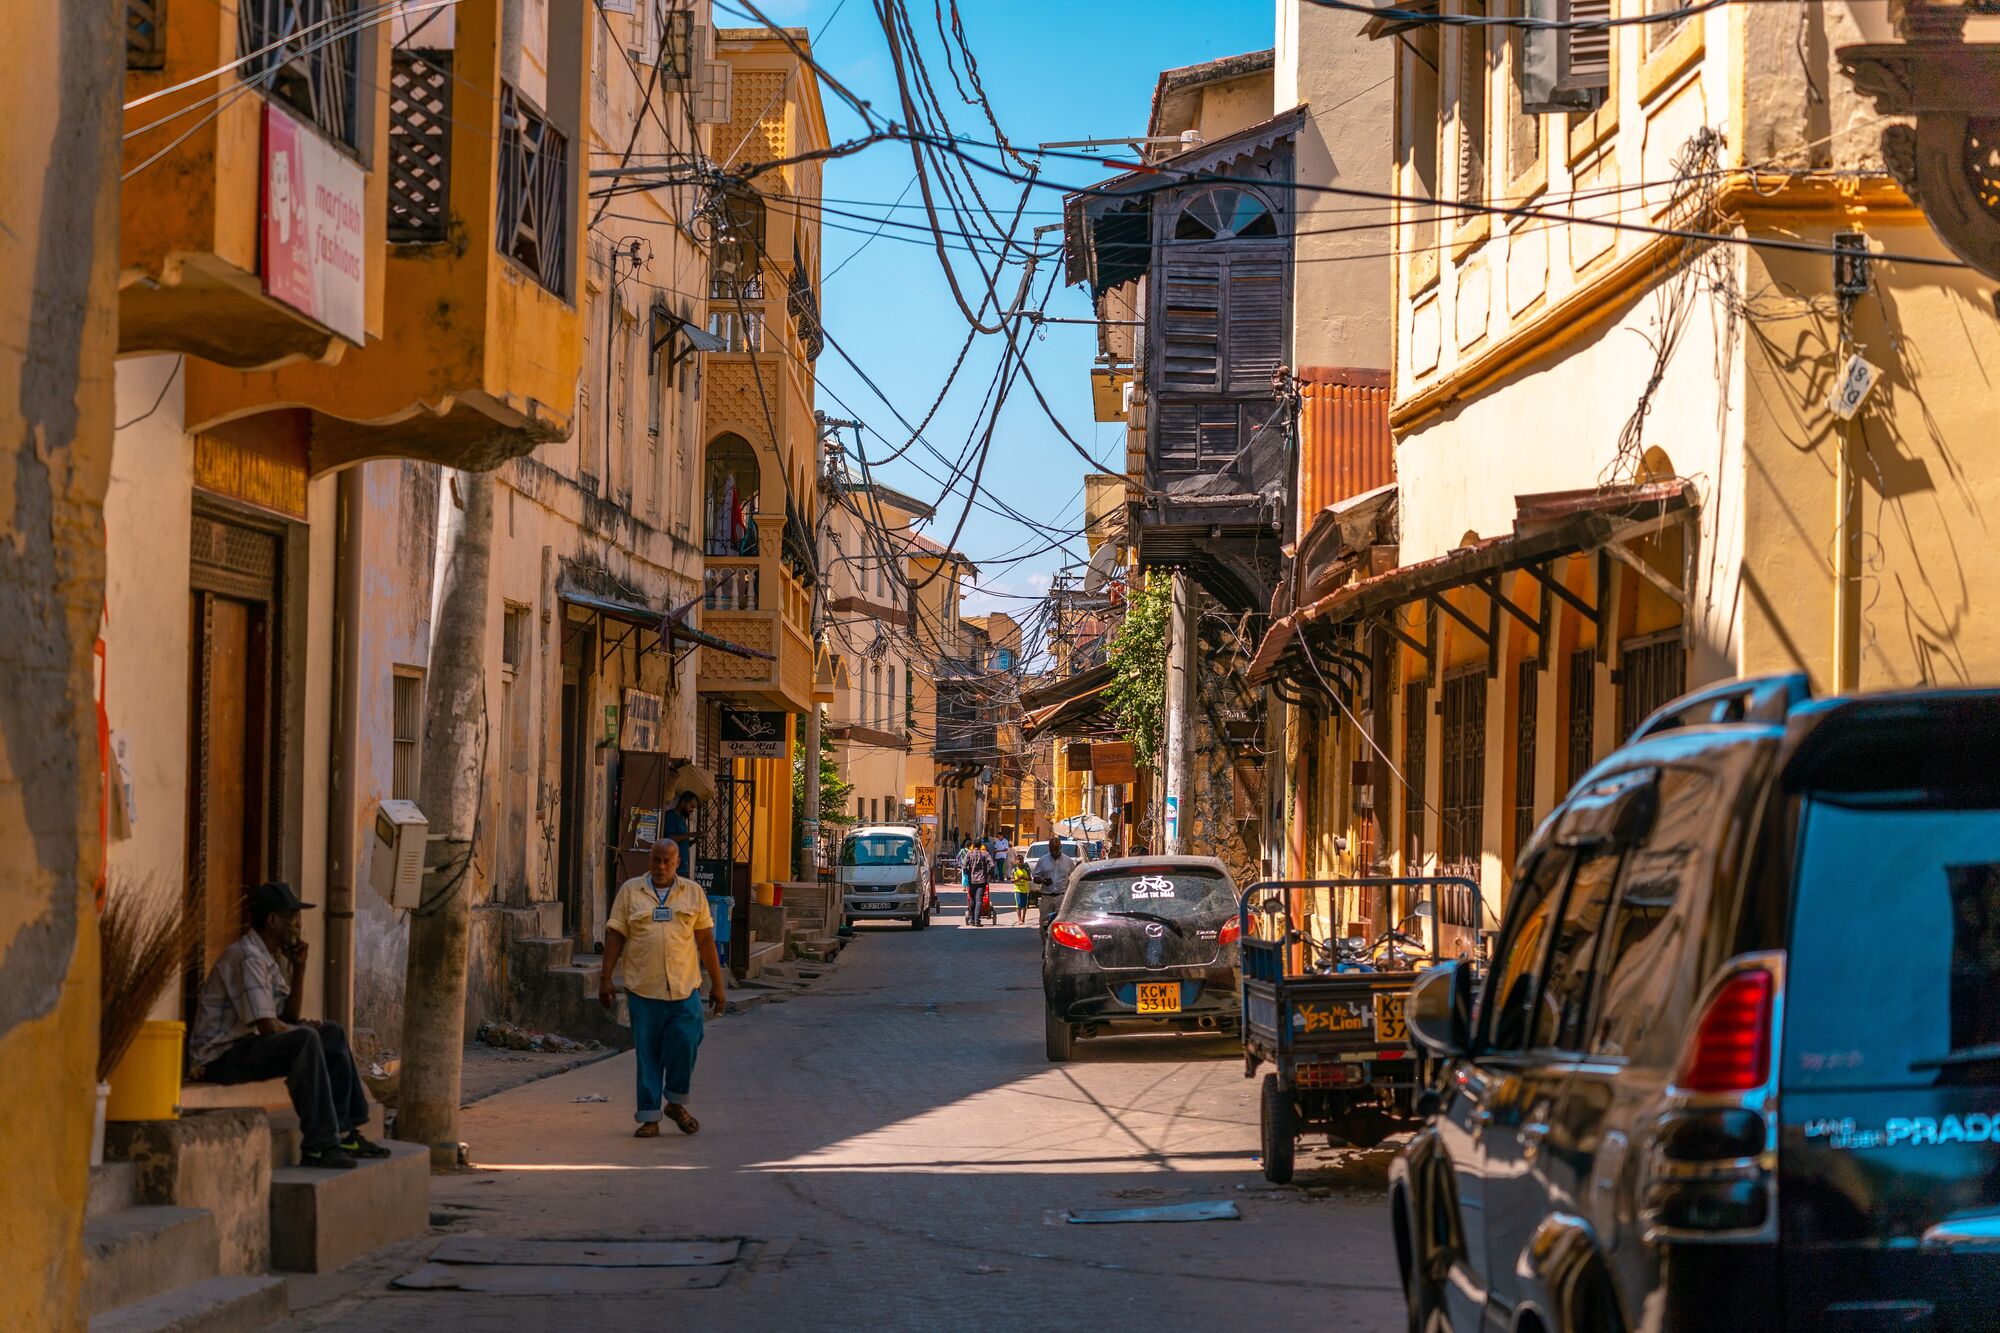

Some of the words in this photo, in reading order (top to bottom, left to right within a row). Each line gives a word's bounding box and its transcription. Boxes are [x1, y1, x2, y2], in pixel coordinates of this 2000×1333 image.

[314, 223, 360, 282] fashions
[1140, 985, 1167, 998] KCW
[1141, 998, 1177, 1010] 331U
[1298, 1003, 1329, 1033] Yes
[1329, 1014, 1361, 1031] Lion
[1383, 1019, 1407, 1038] 37
